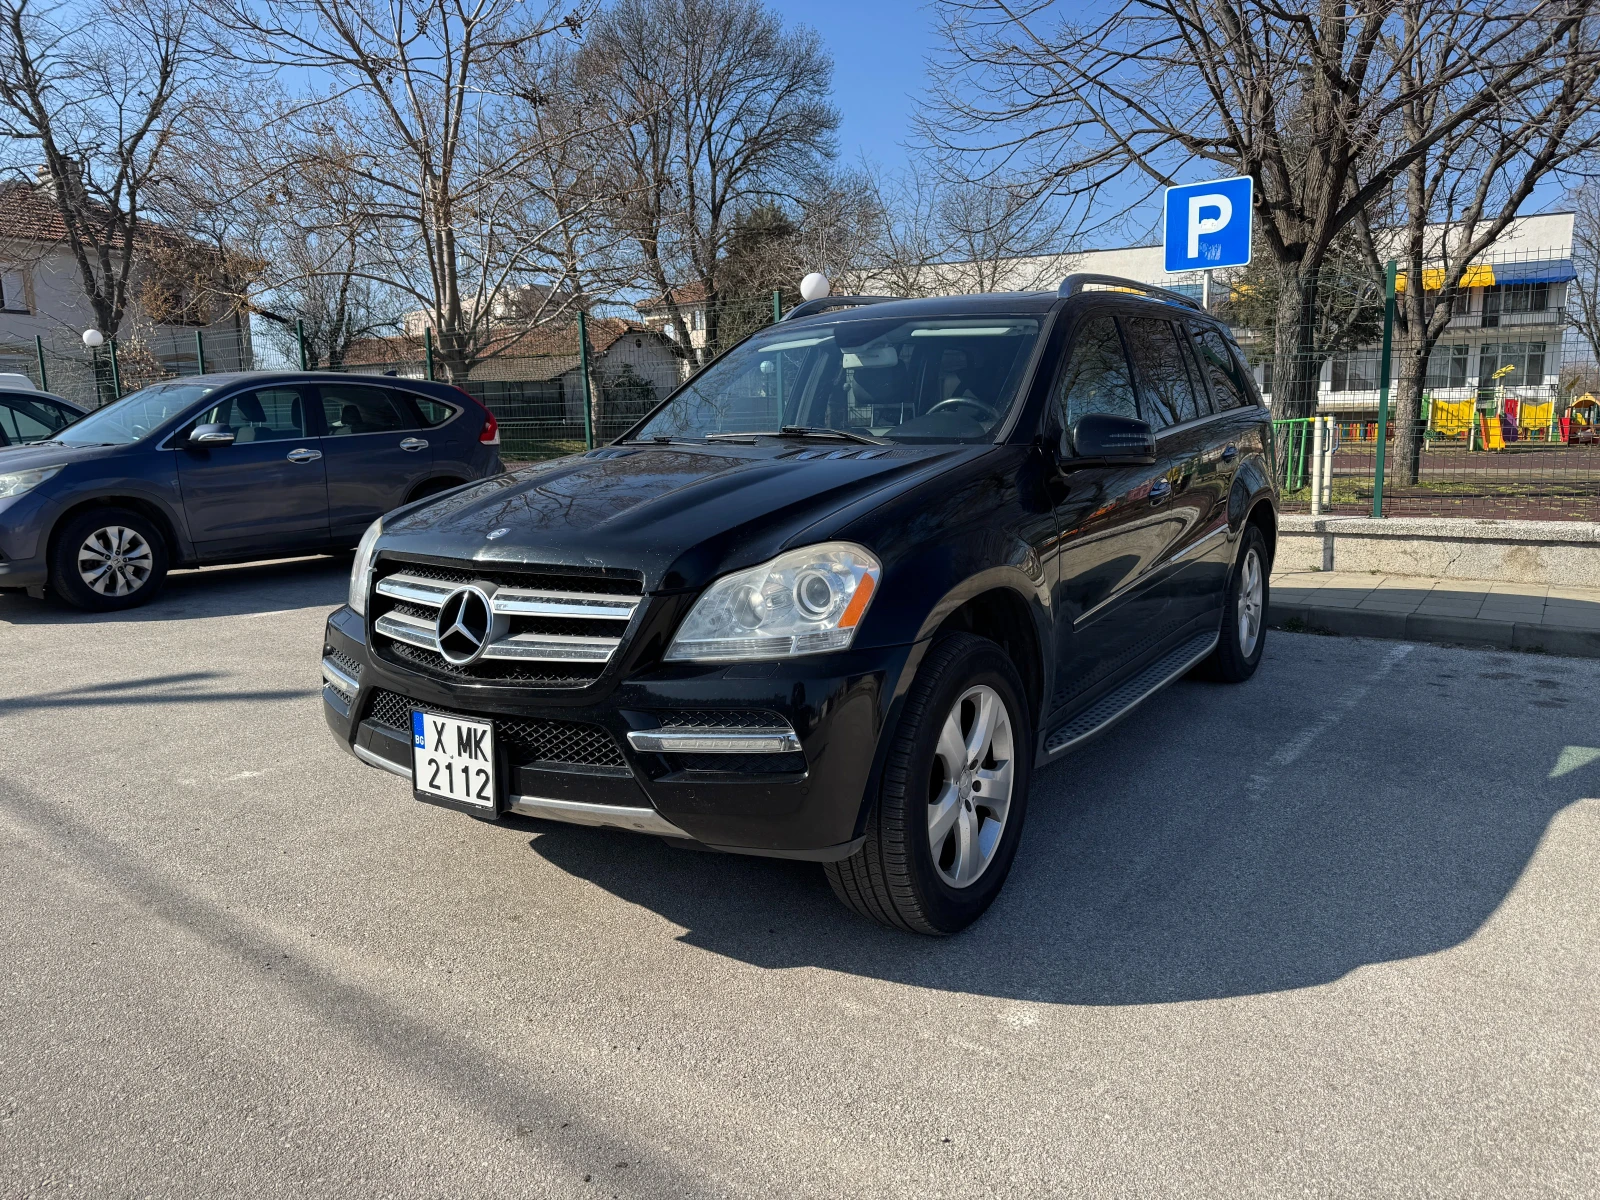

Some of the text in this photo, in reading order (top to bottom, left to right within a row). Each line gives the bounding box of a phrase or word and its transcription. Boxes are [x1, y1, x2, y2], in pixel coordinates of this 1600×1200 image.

[1187, 193, 1232, 259] P
[415, 734, 425, 746] BG
[432, 720, 490, 763] X MK
[427, 757, 491, 802] 2112
